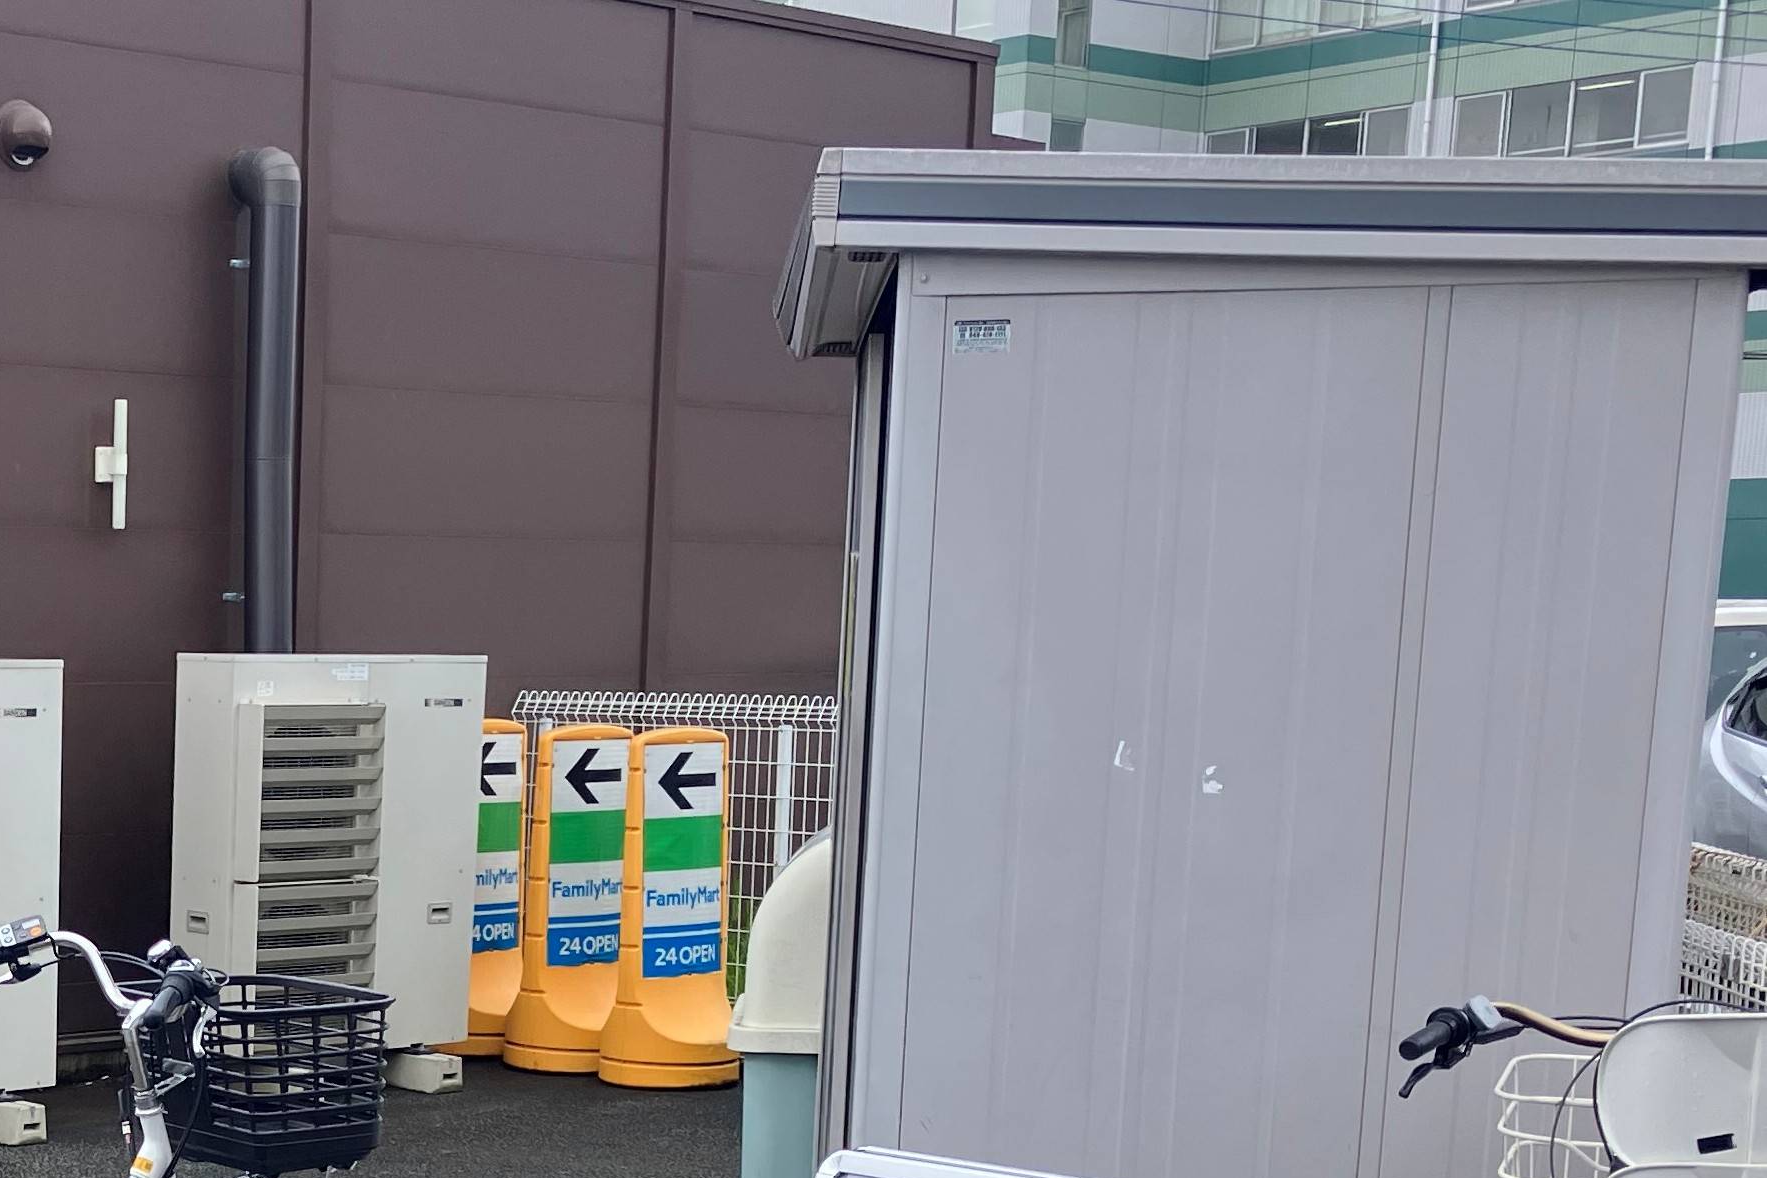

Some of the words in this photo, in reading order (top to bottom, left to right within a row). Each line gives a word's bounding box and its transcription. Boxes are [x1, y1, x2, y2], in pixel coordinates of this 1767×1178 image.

[646, 886, 720, 909] FamilyMart
[482, 922, 515, 941] OPEN
[559, 936, 581, 956] 24
[655, 946, 677, 966] 24
[678, 943, 716, 965] OPEN
